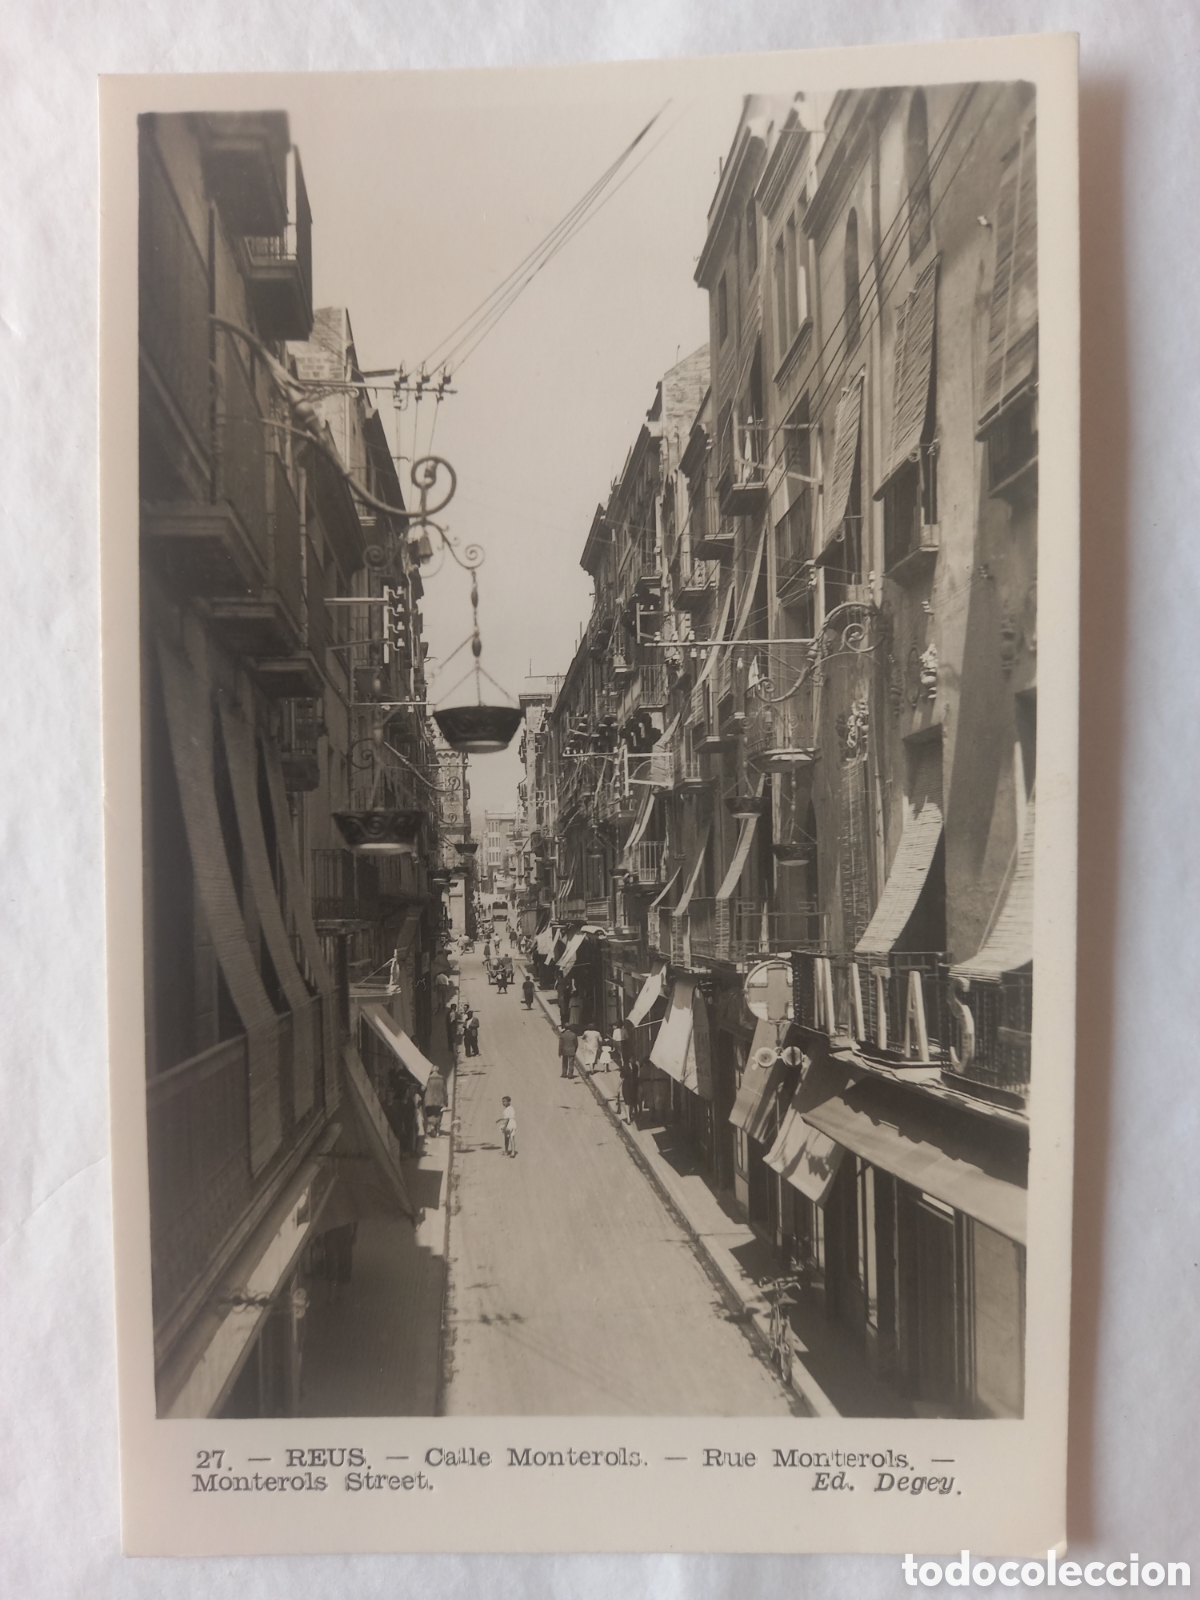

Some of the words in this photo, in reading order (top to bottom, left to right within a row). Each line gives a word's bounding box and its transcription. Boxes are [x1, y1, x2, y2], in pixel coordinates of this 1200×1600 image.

[195, 1450, 233, 1472] 27.
[284, 1447, 372, 1471] REUS.
[424, 1446, 492, 1468] Calle
[506, 1447, 647, 1467] Monterols.
[702, 1448, 757, 1468] Rue
[771, 1448, 915, 1472] Monterols.
[192, 1472, 328, 1493] Monterols
[344, 1470, 434, 1492] Street.
[811, 1472, 855, 1492] Ed.
[873, 1472, 962, 1496] Degey.
